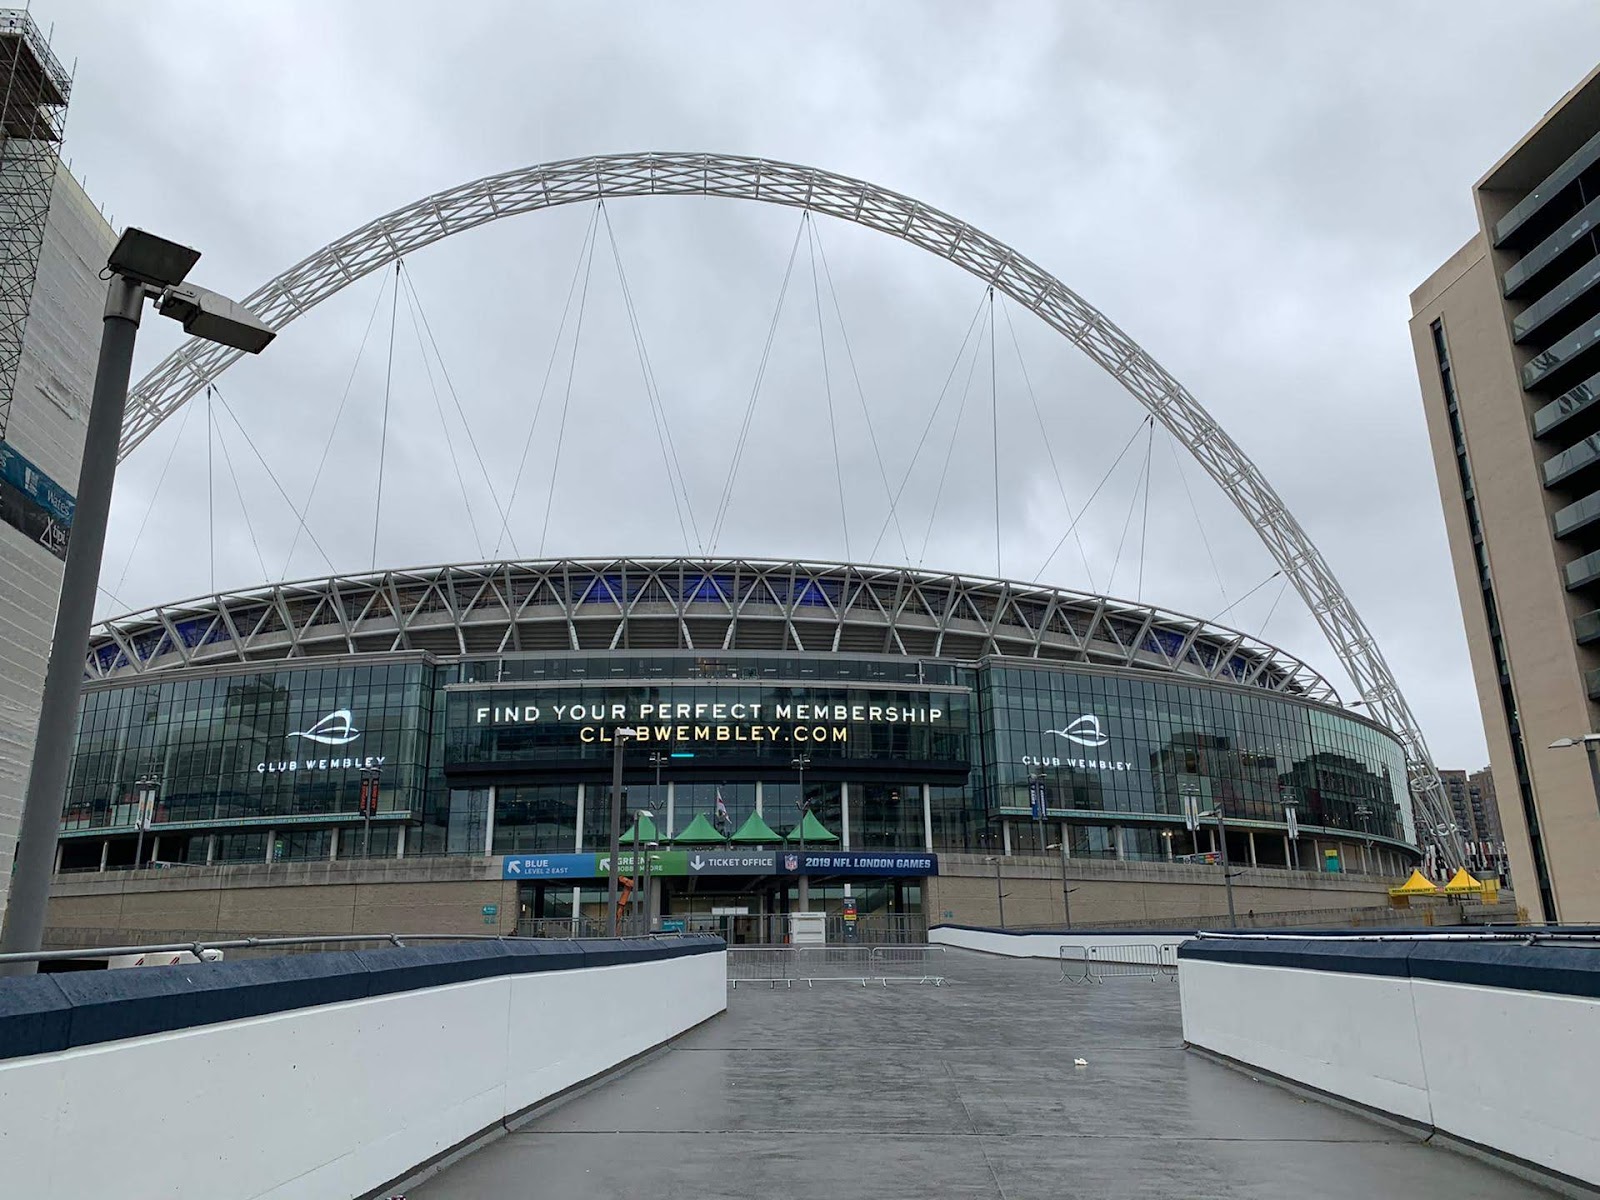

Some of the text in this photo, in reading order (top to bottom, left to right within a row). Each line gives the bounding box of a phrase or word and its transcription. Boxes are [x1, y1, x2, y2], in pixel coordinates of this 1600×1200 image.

[476, 703, 943, 724] FIND YOUR PERFECT MEMBERSHIP
[580, 725, 848, 743] CLBWEMBLEY.COM
[256, 756, 386, 774] CLUB WEMBLEY
[1022, 755, 1132, 772] CLUB WEMBLEY
[524, 859, 549, 868] BLUE
[616, 856, 646, 865] GREN
[708, 857, 773, 867] TICKET OFFICE
[804, 857, 932, 869] 2019 NFL LONDON GAMES
